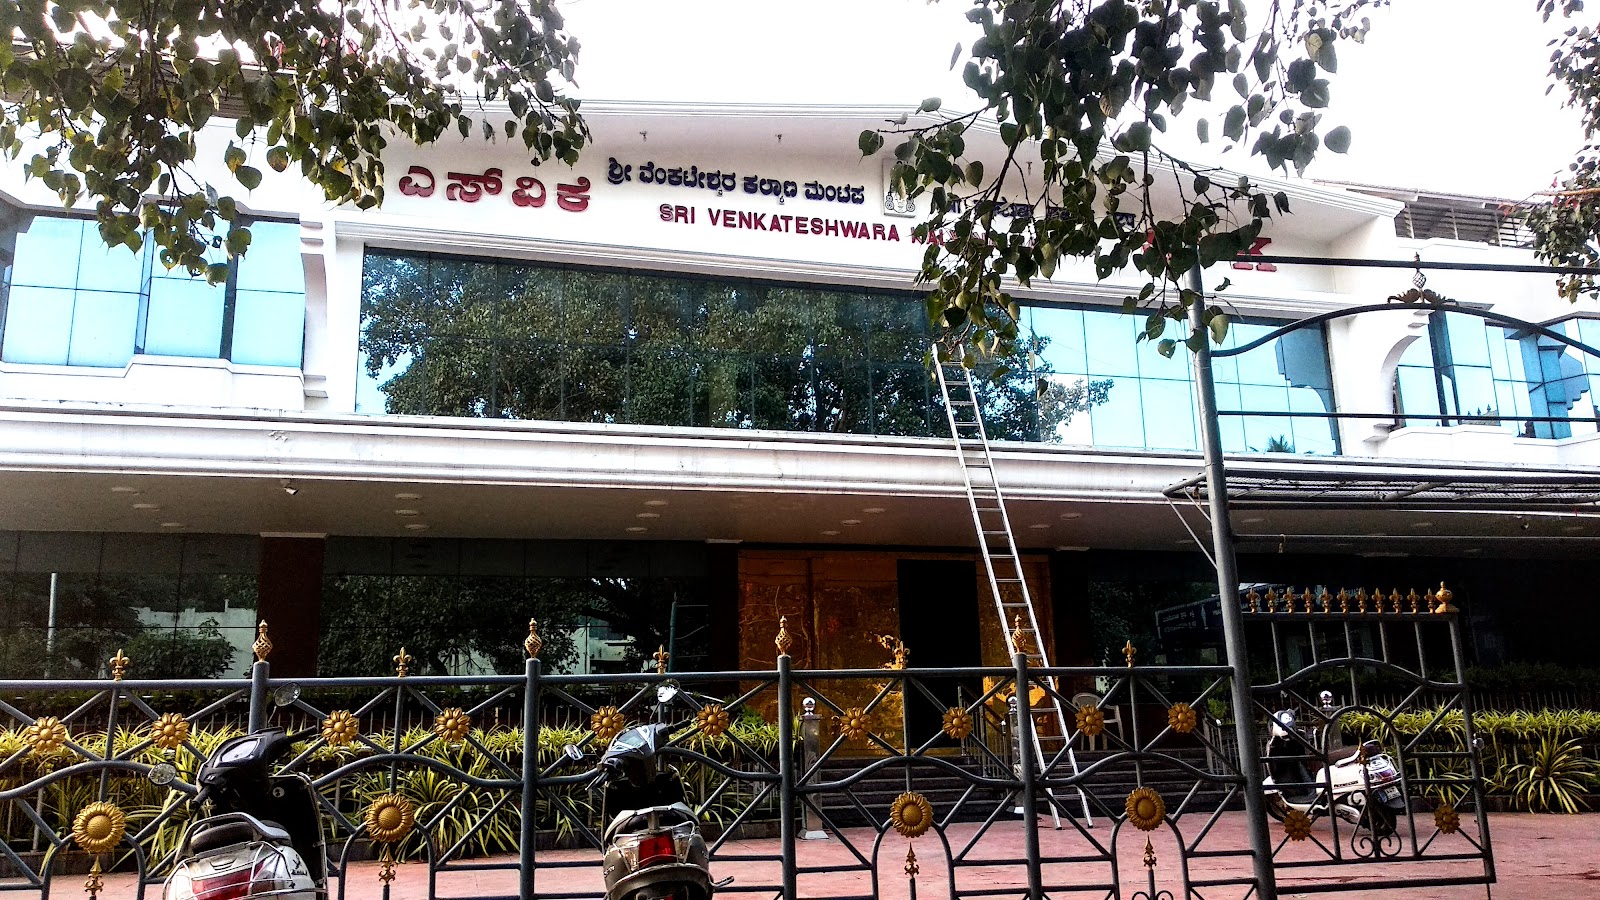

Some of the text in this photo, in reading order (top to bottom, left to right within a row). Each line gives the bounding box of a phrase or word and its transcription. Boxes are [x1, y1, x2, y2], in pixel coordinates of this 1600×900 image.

[607, 156, 865, 205] ಶ್ರೀ ವೆಂಕಟೇಶ್ವರ ಕಲ್ಯಾಣ ಮಂಟಪ
[659, 203, 695, 225] SRI
[708, 207, 900, 242] VENKATESHWARA
